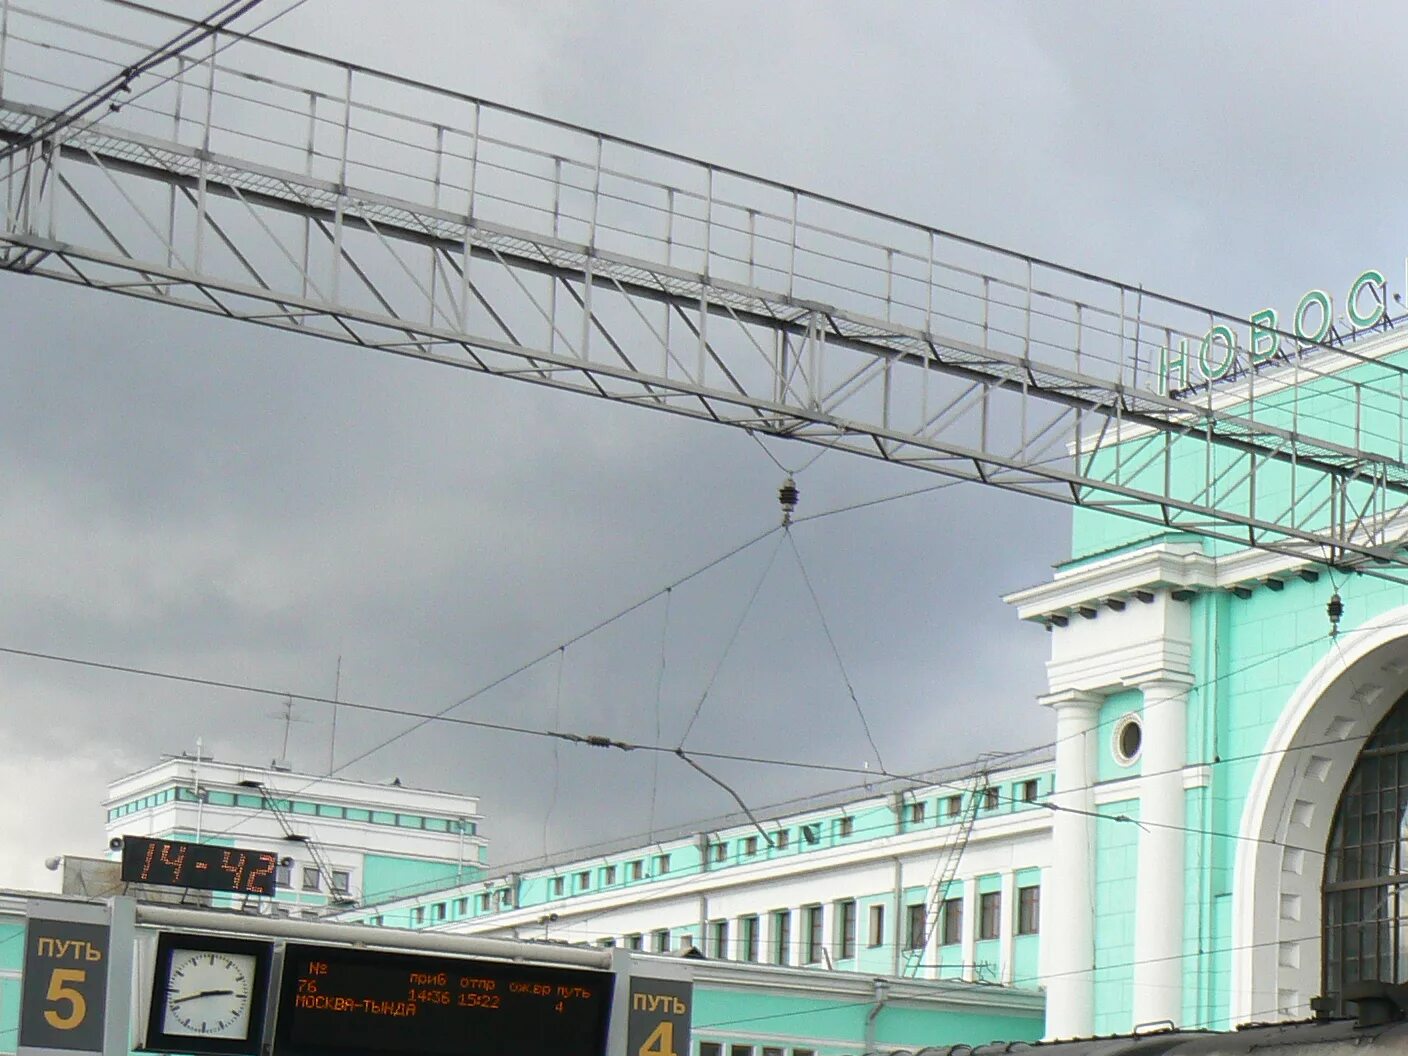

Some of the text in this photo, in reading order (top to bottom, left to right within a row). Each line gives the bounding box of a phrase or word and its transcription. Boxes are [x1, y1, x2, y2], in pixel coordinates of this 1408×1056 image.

[140, 843, 277, 894] 14-42
[37, 937, 102, 961] ПУТЬ
[308, 960, 329, 976] №
[409, 972, 448, 986] приб
[460, 977, 496, 991] отпр
[43, 968, 86, 1030] 5
[633, 993, 686, 1014] ПУТЬ
